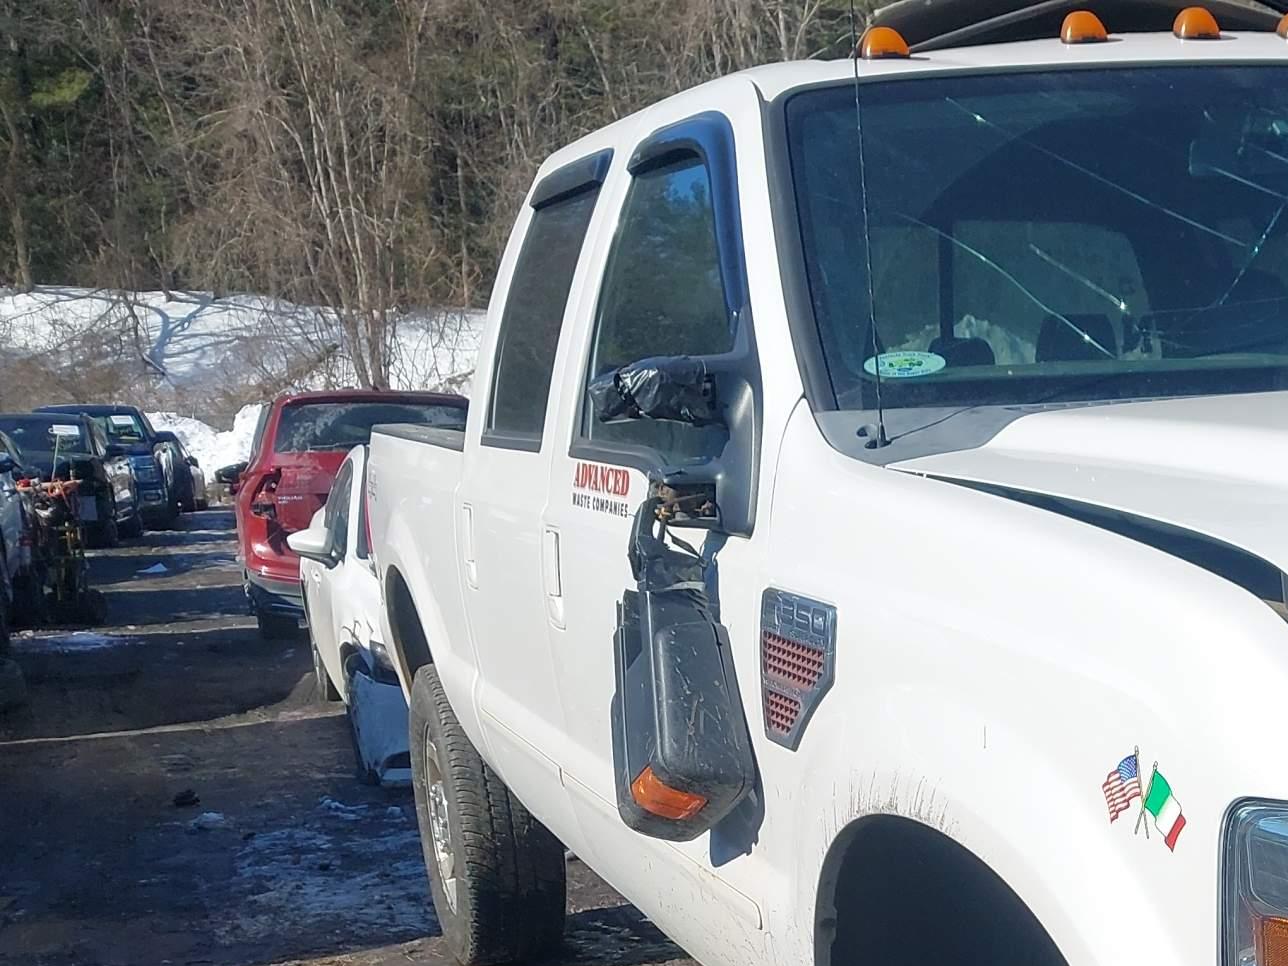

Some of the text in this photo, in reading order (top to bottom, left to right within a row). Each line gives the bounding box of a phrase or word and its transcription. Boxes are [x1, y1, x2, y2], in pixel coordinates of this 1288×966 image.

[573, 462, 630, 496] ADVANCED
[572, 492, 629, 518] WASTE COMPANIES
